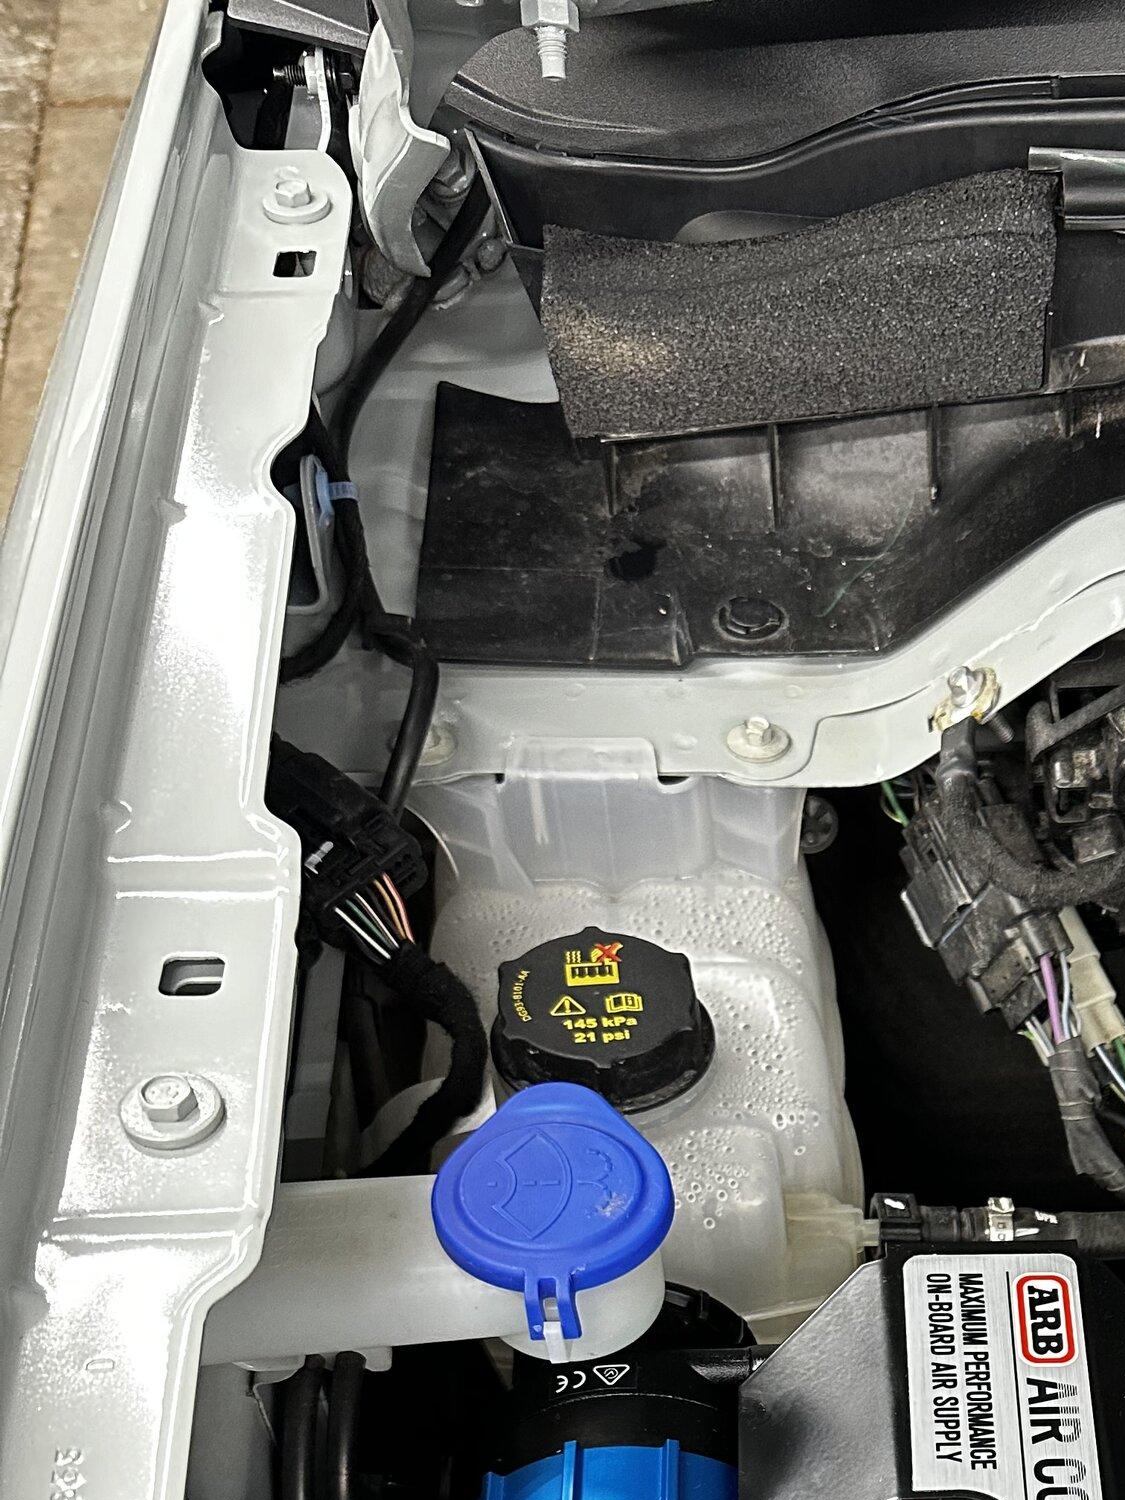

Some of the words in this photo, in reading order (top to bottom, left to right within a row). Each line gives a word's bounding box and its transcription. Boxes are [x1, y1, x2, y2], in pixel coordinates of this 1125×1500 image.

[562, 1018, 598, 1030] 145
[602, 1016, 638, 1028] kPa
[574, 1031, 596, 1044] 21
[602, 1029, 631, 1043] psi
[926, 1273, 956, 1356] ON-BOARD
[958, 1273, 989, 1346] MAXIMUM
[1027, 1285, 1065, 1356] ARB
[931, 1362, 958, 1390] AIR
[932, 1396, 963, 1463] SUPPLY
[963, 1351, 998, 1471] PERFORMANCE
[1026, 1377, 1081, 1445] AIR
